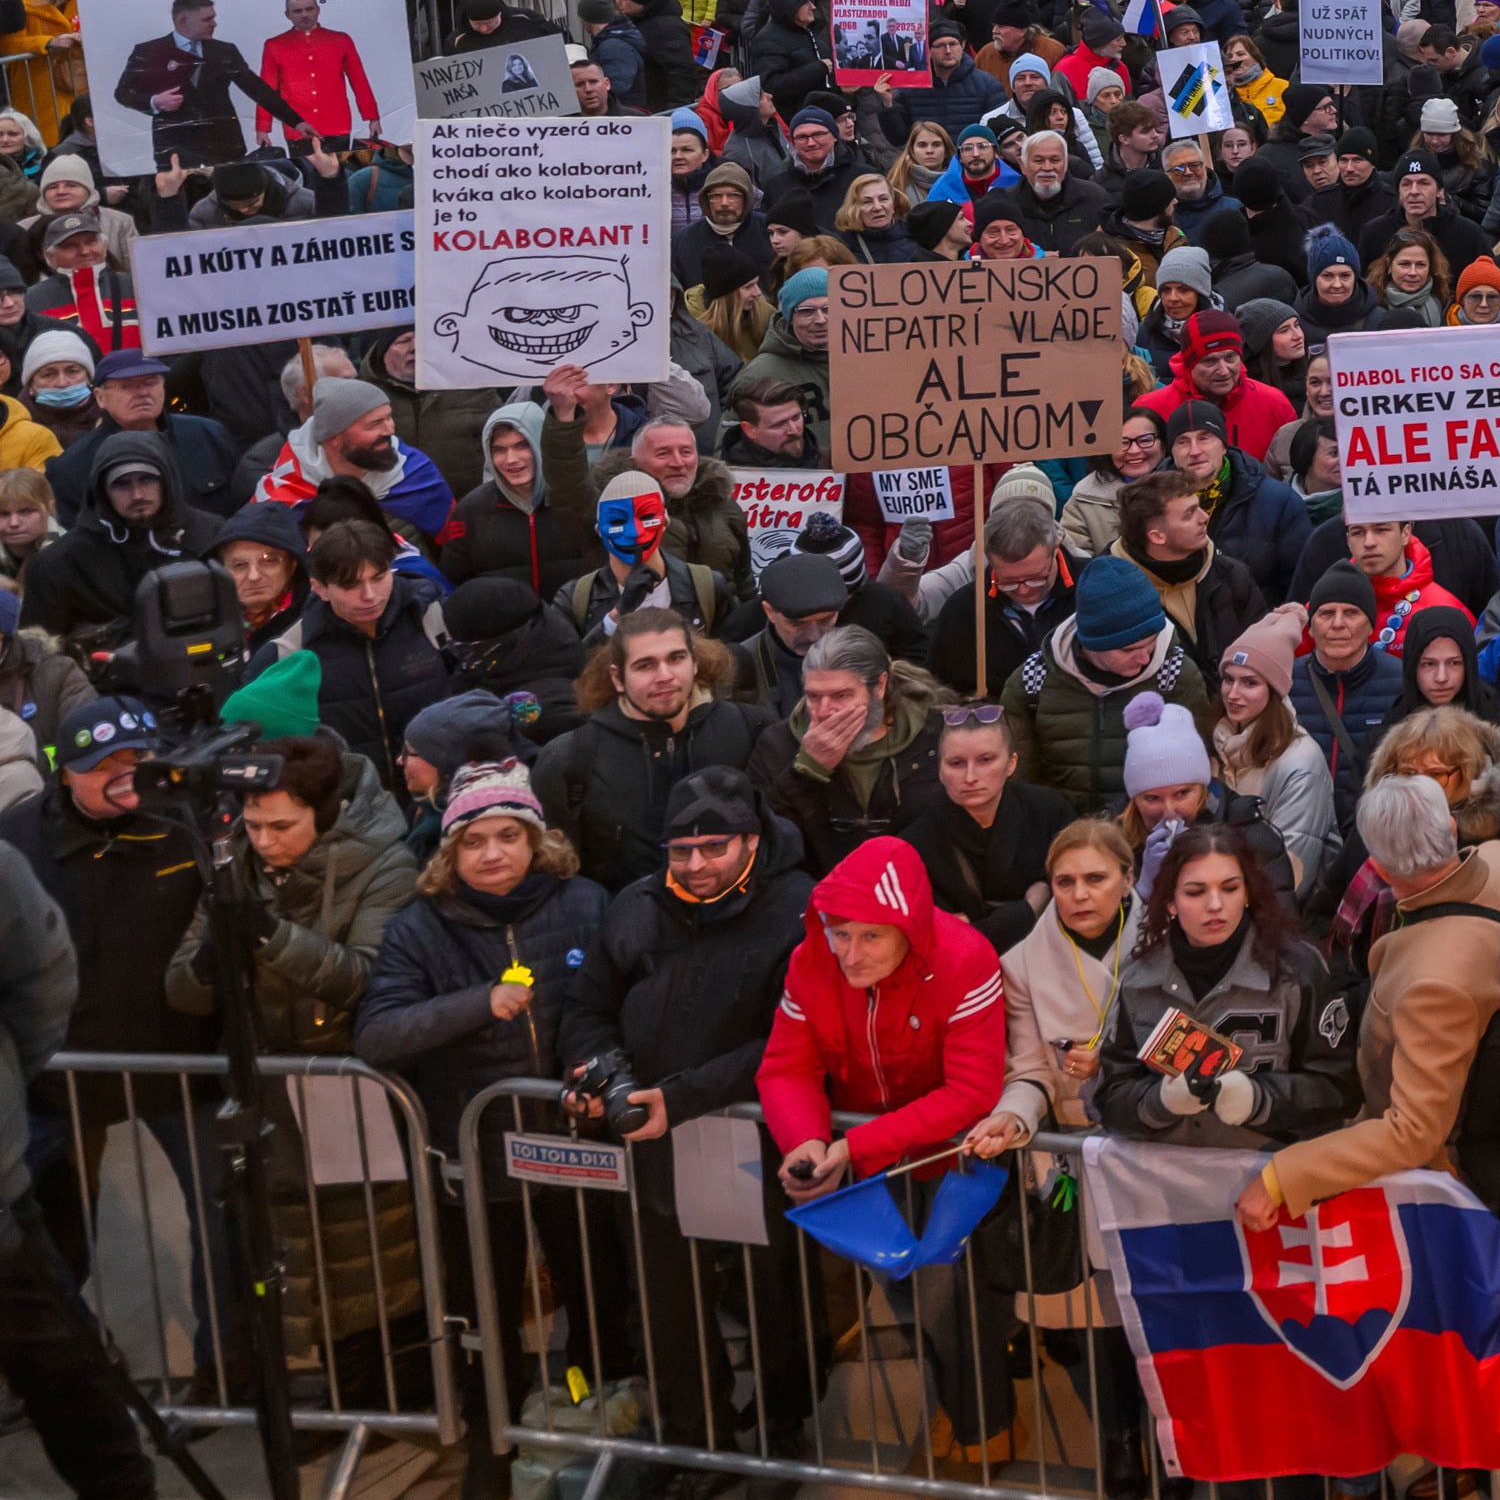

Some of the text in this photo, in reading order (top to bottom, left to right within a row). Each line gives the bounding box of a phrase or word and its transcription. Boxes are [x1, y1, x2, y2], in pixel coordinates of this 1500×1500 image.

[1311, 5, 1368, 21] UŽ SPÄŤ
[1303, 25, 1374, 41] NUDNÝCH
[1302, 47, 1380, 61] POLITIKOV!
[419, 58, 484, 91] NAVŽDY
[432, 121, 632, 140] Ak niečo vyzerá ako
[432, 143, 544, 159] kolaborant,
[432, 161, 648, 180] chodí ako kolaborant,
[432, 184, 652, 203] kváka ako kolaborant,
[433, 208, 477, 226] je to
[433, 224, 634, 251] KOLABORANT
[165, 237, 396, 279] AJ KÚTY ZÁHORIE
[839, 264, 1098, 308] SLOVENSKO
[178, 291, 357, 336] MUSIA ZOSTAŤ
[841, 304, 1117, 353] NEPATRÍ VLÁDE,
[915, 352, 1041, 404] ALE
[1337, 369, 1405, 387] DIABOL
[1411, 366, 1454, 383] FICO
[1459, 364, 1484, 380] SA
[1339, 391, 1456, 417] CIRKEV
[847, 400, 1104, 462] OBČANOM!
[1346, 422, 1432, 467] ALE
[879, 468, 945, 493] MY SME
[1347, 471, 1381, 497] TÁ
[1388, 466, 1498, 495] PRINÁŠA
[883, 490, 948, 515] EURÓPA
[513, 1143, 615, 1168] TOI TOI DIXI
